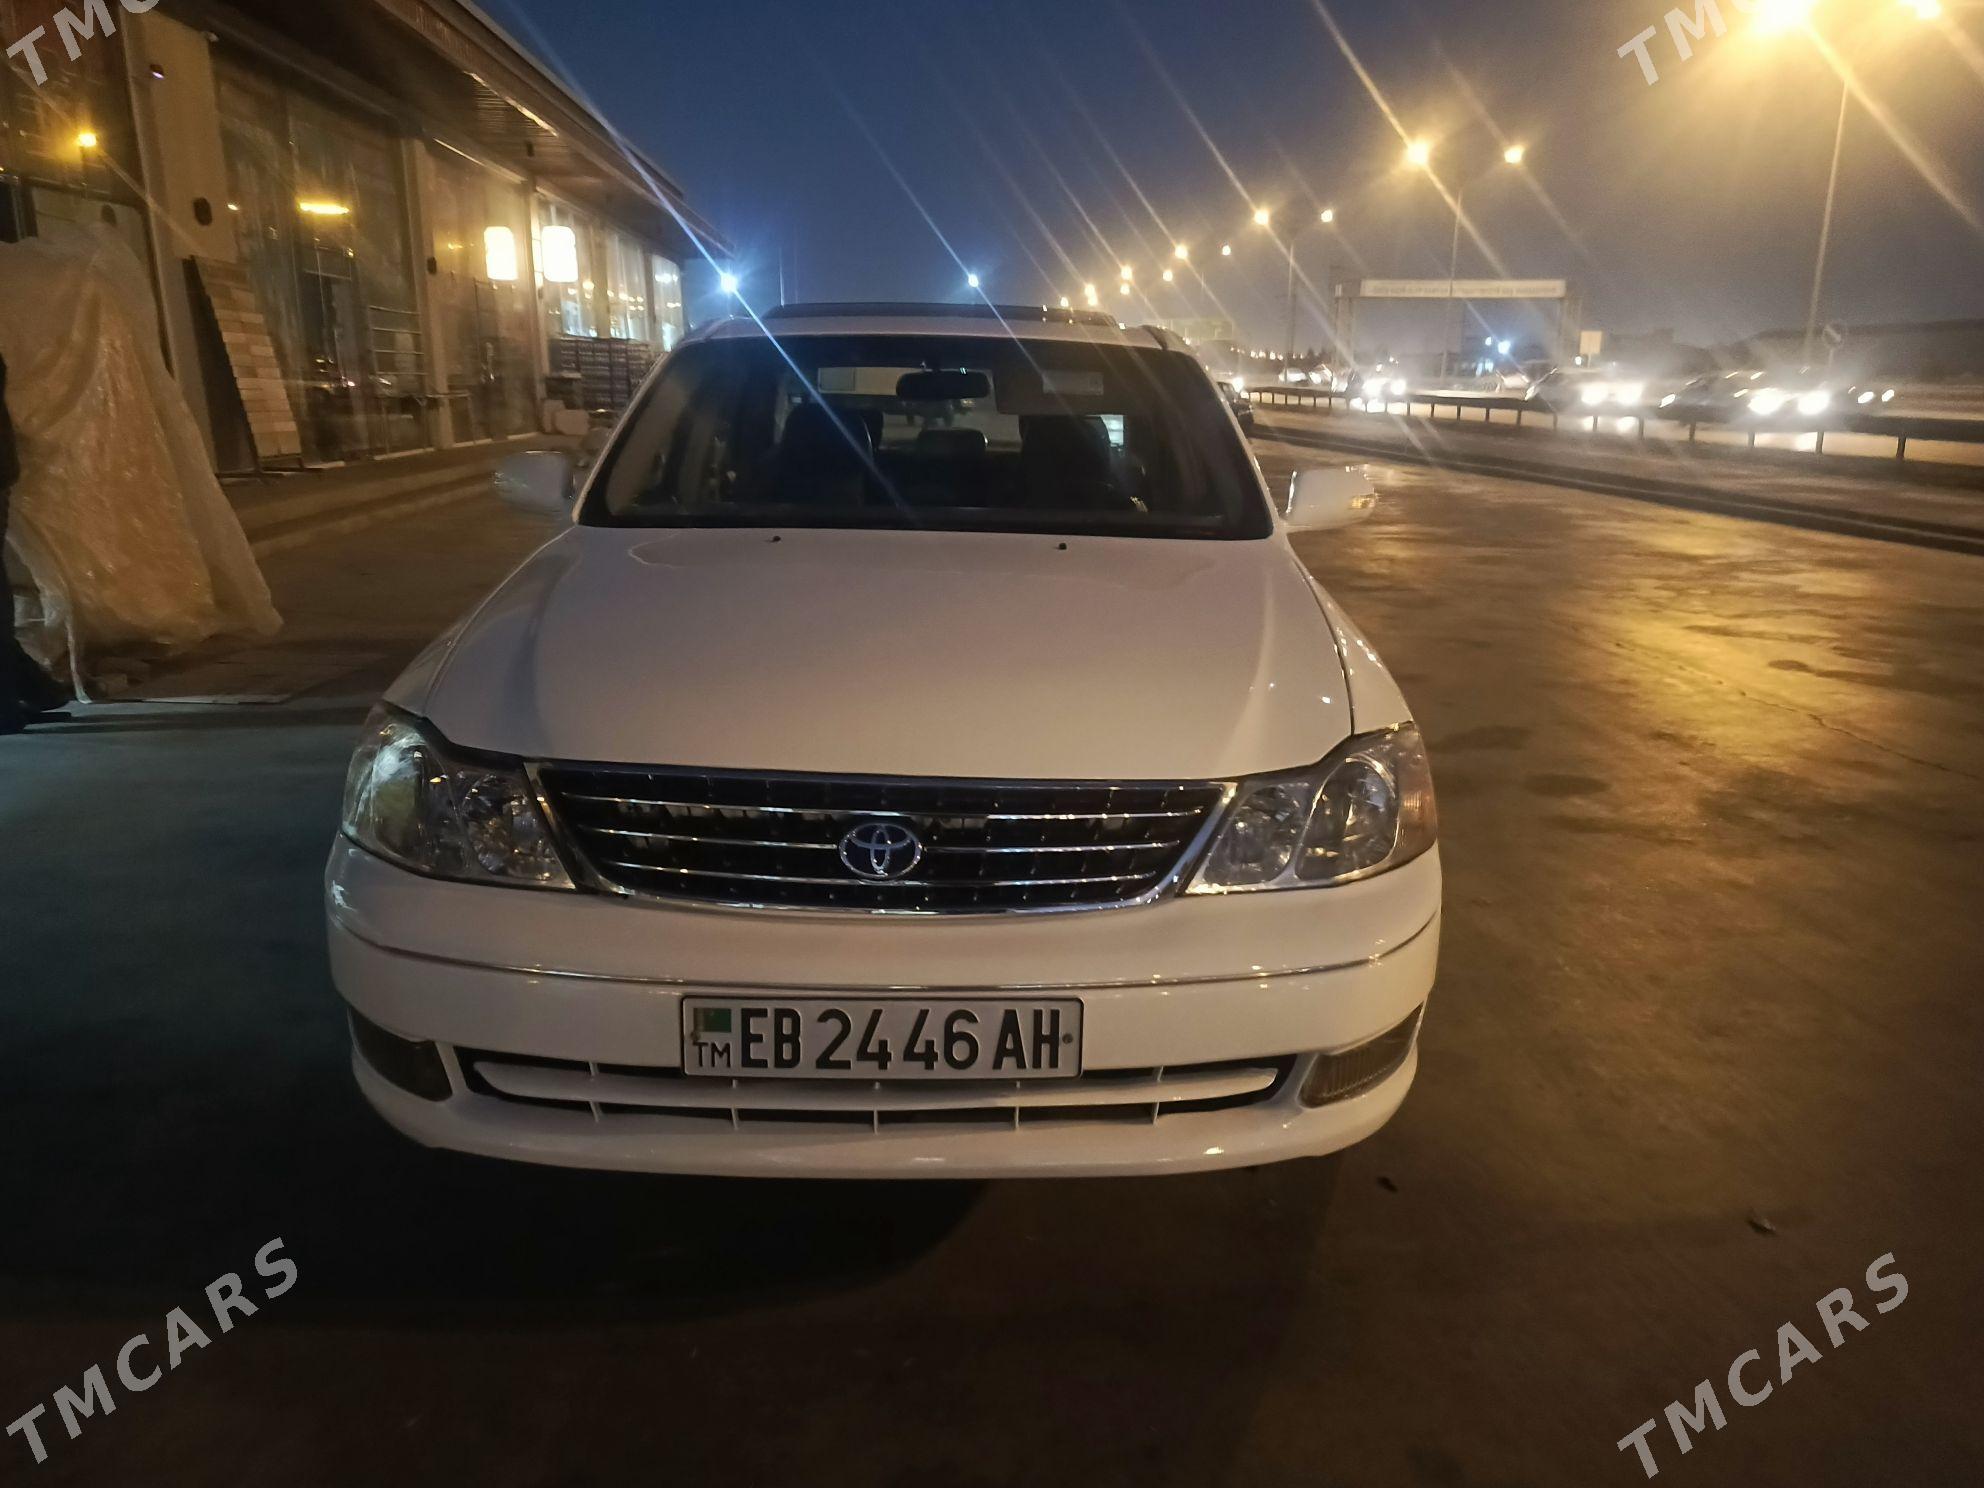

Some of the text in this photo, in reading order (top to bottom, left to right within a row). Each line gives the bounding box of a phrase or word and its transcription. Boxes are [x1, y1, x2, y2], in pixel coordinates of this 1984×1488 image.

[692, 1041, 731, 1067] TM
[741, 1008, 1060, 1070] EB 2446 AH
